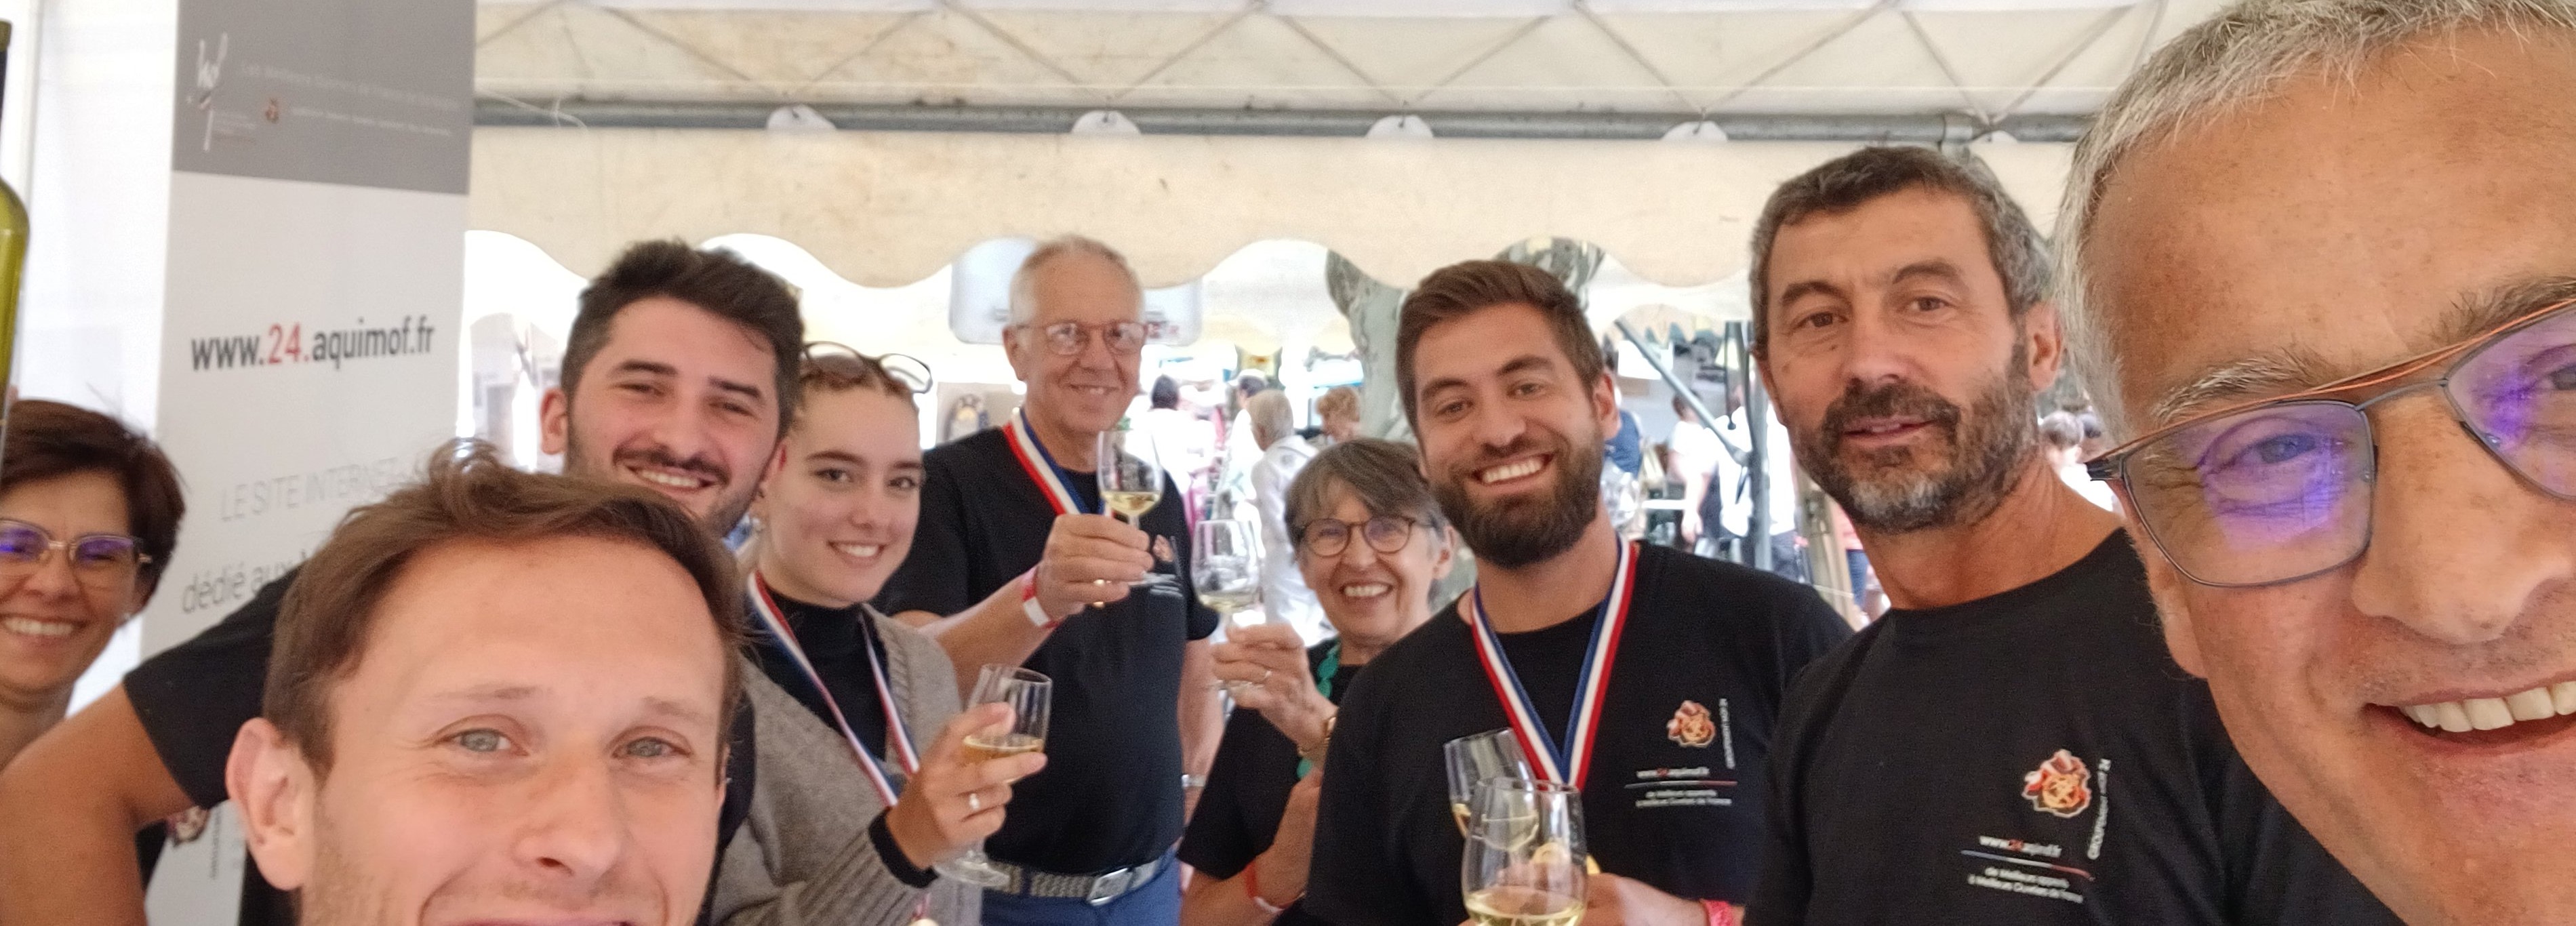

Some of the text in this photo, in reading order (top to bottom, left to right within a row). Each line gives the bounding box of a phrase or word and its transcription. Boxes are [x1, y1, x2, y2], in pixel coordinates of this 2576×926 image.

[191, 315, 434, 370] www.24.aquimof.fr
[221, 482, 247, 521] LE
[253, 475, 300, 515] SITE
[182, 562, 247, 614] dédié
